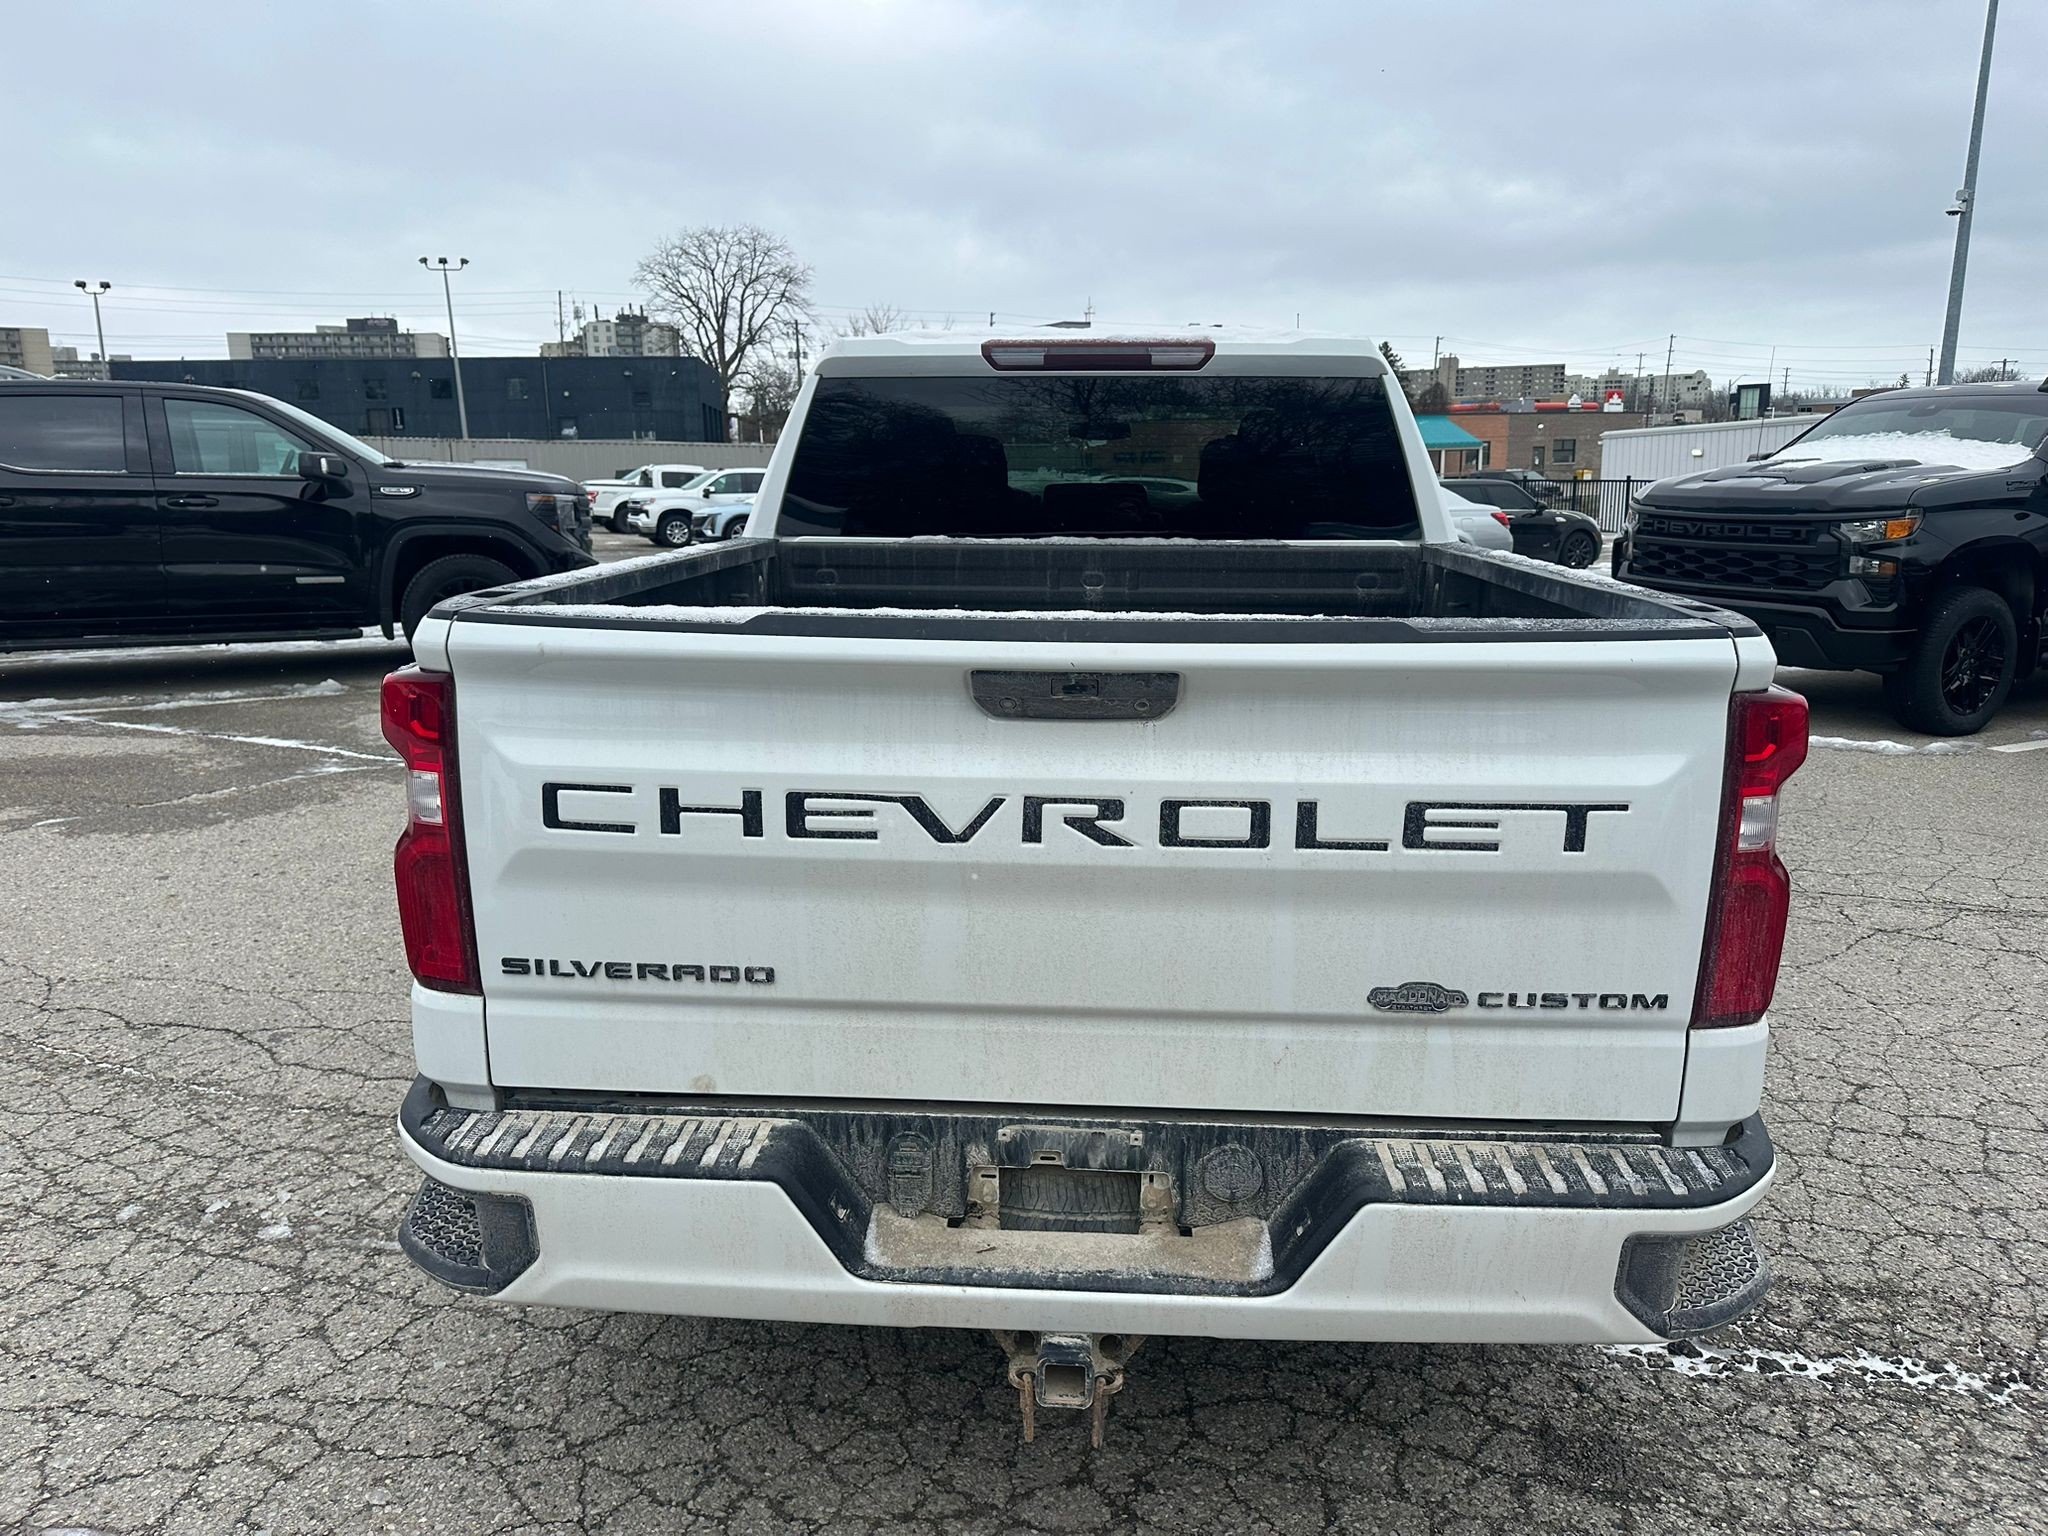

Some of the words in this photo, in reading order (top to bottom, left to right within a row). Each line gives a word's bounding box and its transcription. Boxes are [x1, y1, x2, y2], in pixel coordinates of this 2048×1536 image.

[1640, 517, 1815, 541] CHEVROLET
[542, 782, 1630, 854] CHEVROLET
[501, 956, 775, 984] SILVERADO
[1477, 991, 1669, 1010] CUSTOM
